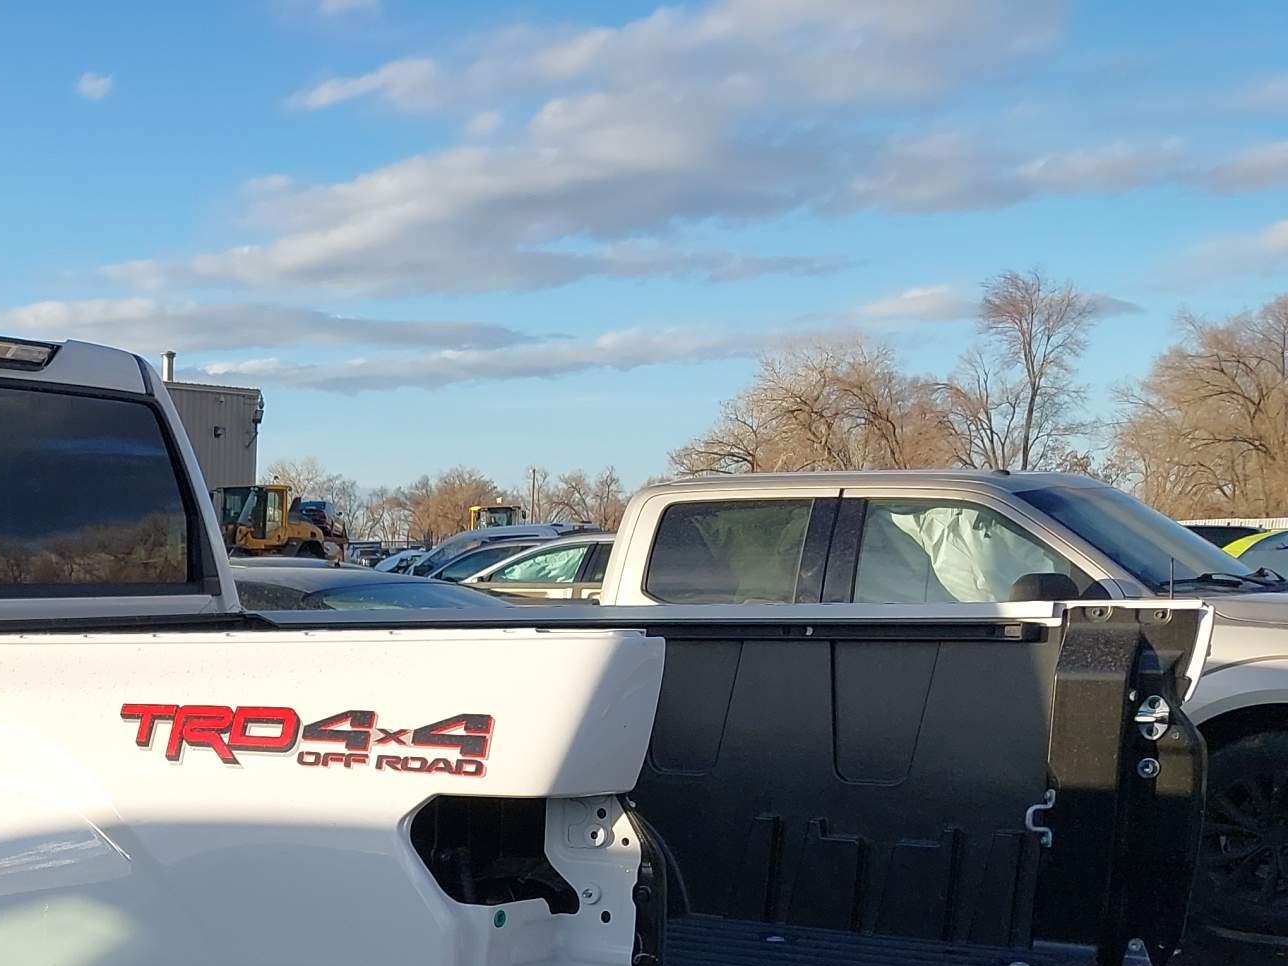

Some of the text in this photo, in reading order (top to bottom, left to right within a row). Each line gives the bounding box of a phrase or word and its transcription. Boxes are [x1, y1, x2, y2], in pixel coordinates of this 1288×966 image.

[120, 703, 305, 766] TRD
[297, 751, 488, 778] OFF ROAD
